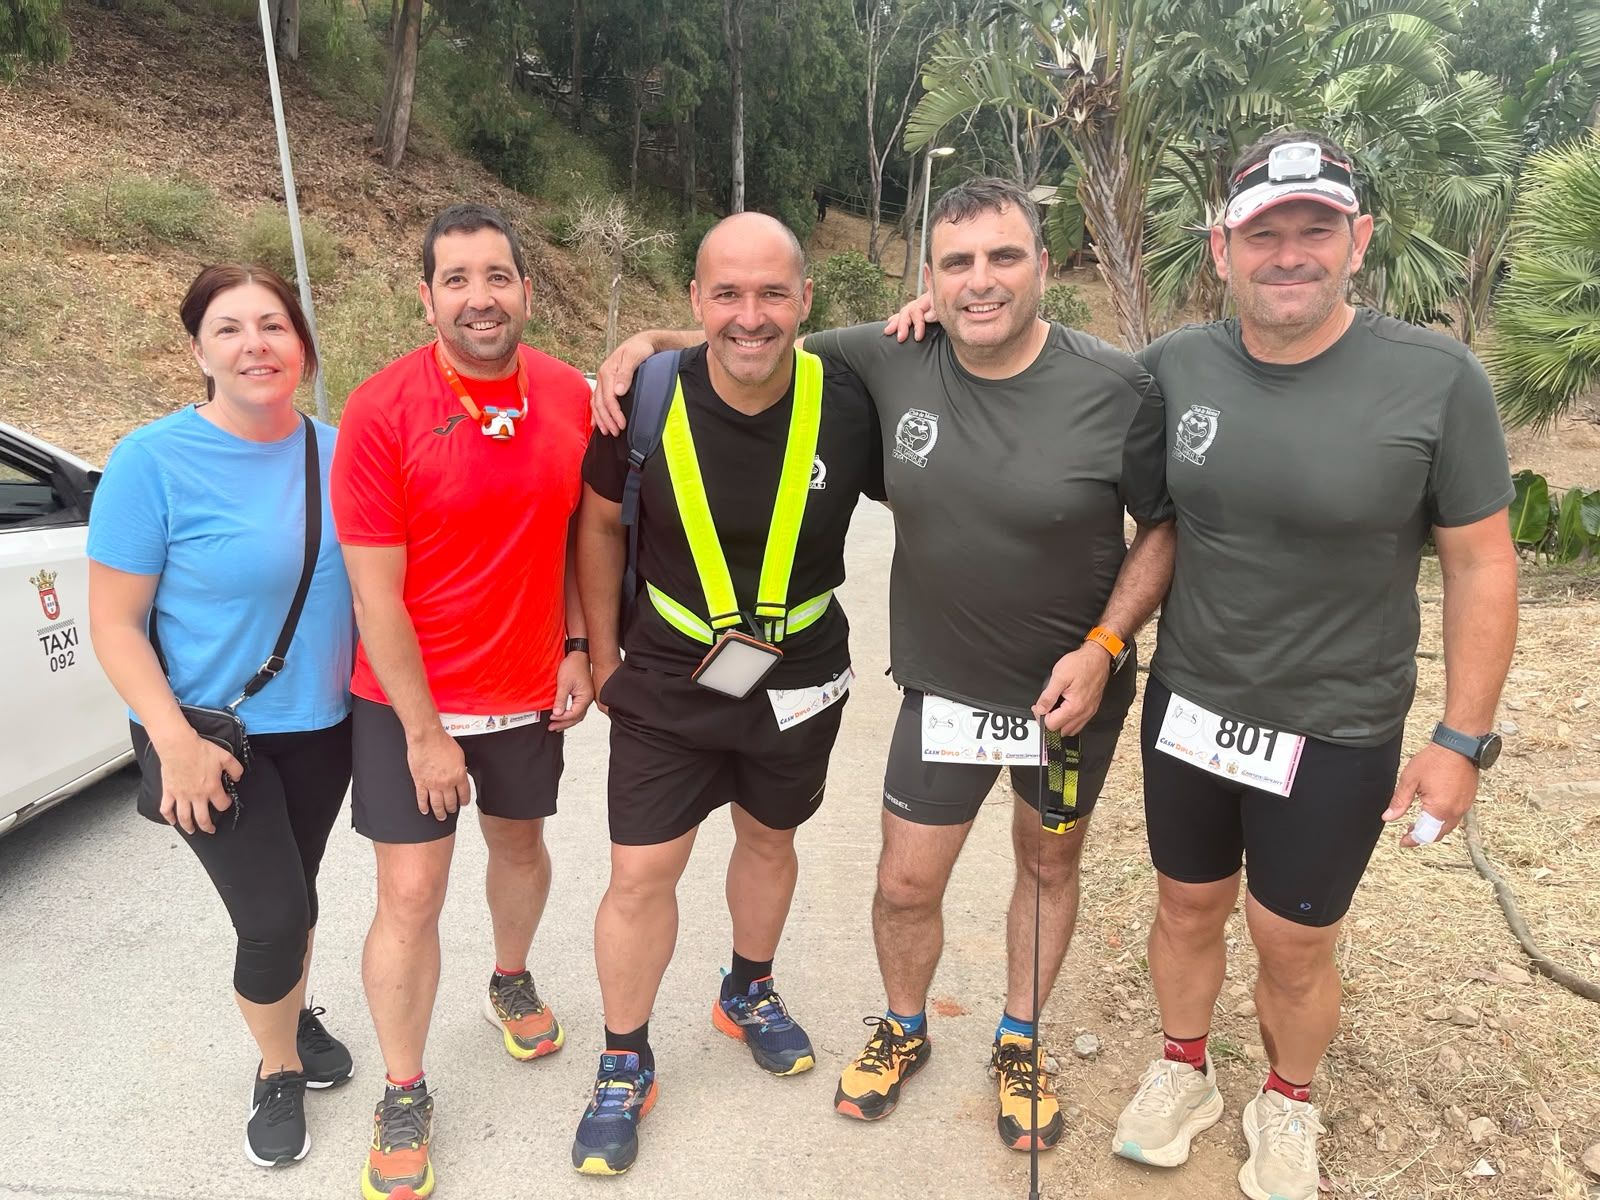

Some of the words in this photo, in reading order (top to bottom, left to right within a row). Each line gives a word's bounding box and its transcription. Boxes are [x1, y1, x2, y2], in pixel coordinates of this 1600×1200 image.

[39, 626, 79, 656] TAXI
[50, 650, 76, 673] 092
[972, 711, 1029, 741] 798
[1215, 716, 1279, 762] 801
[1159, 736, 1175, 748] CASH
[1175, 742, 1194, 756] DIPLO
